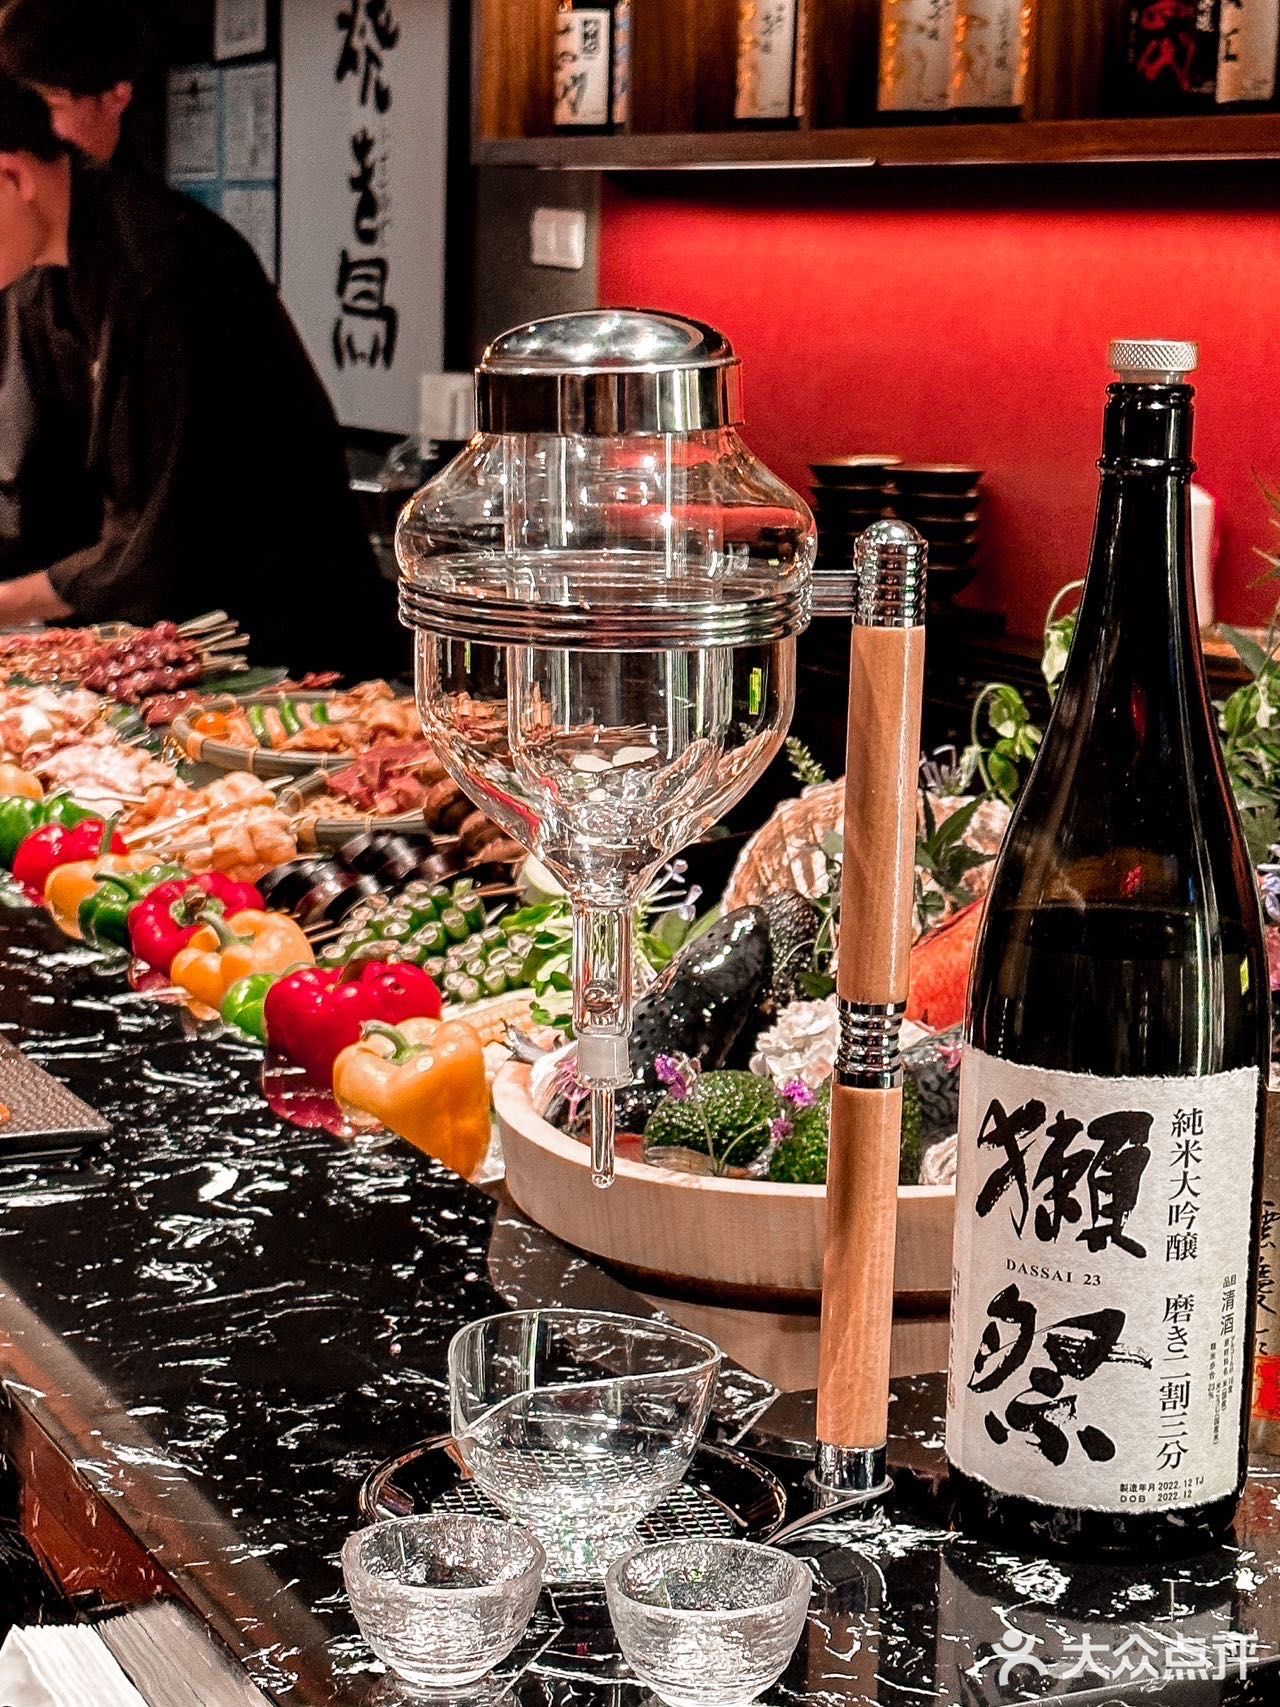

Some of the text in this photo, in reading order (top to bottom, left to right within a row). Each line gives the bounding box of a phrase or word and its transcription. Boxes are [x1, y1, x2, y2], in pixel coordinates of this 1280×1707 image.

[1006, 1257, 1101, 1286] DASSAI 23
[1156, 1107, 1204, 1471] 純米大吟醸 磨き二割三分
[1220, 1289, 1236, 1336] 清酒
